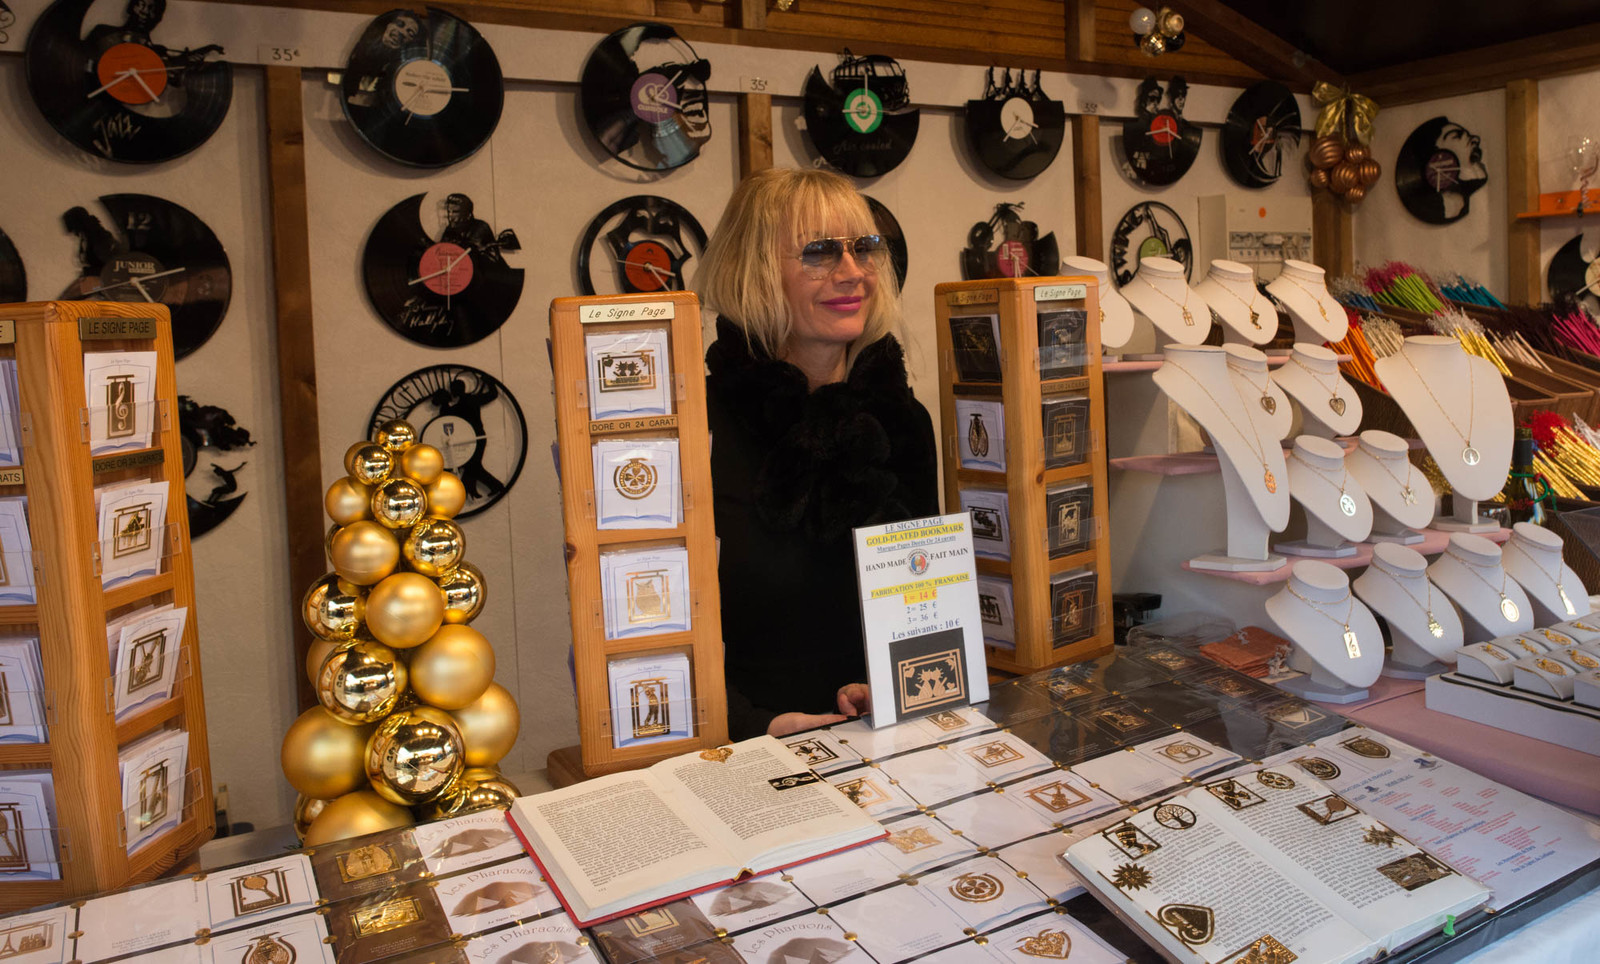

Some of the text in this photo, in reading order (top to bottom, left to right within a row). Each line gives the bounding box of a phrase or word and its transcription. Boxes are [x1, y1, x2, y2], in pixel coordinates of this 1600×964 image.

[126, 211, 152, 230] 12
[113, 260, 155, 272] JUNIOR
[1040, 287, 1082, 299] Le Signe Page
[588, 306, 666, 320] Le Signe Page
[88, 322, 101, 334] LE
[128, 321, 150, 334] PAGE
[618, 421, 631, 430] OR
[648, 418, 675, 427] CARAT
[884, 517, 944, 534] LE SIGNE PAGE
[866, 524, 964, 546] GOLD-PLATED BOOKMARK
[877, 543, 896, 553] Marque
[930, 547, 969, 561] FAIT MAIN
[865, 562, 886, 572] HAND
[887, 557, 907, 568] MADE
[870, 583, 914, 598] FABRICATION
[919, 591, 928, 601] 14
[931, 588, 938, 599] €
[919, 603, 928, 612] 25
[932, 601, 938, 609] €
[920, 614, 929, 622] 36
[933, 611, 939, 620] €
[892, 630, 906, 641] Les
[906, 623, 938, 637] suivants
[945, 619, 954, 629] 10
[954, 618, 960, 627] €
[441, 867, 535, 897] Les Pharaons
[473, 924, 573, 960] Les Pharaons
[743, 921, 833, 955] Les Pharaons
